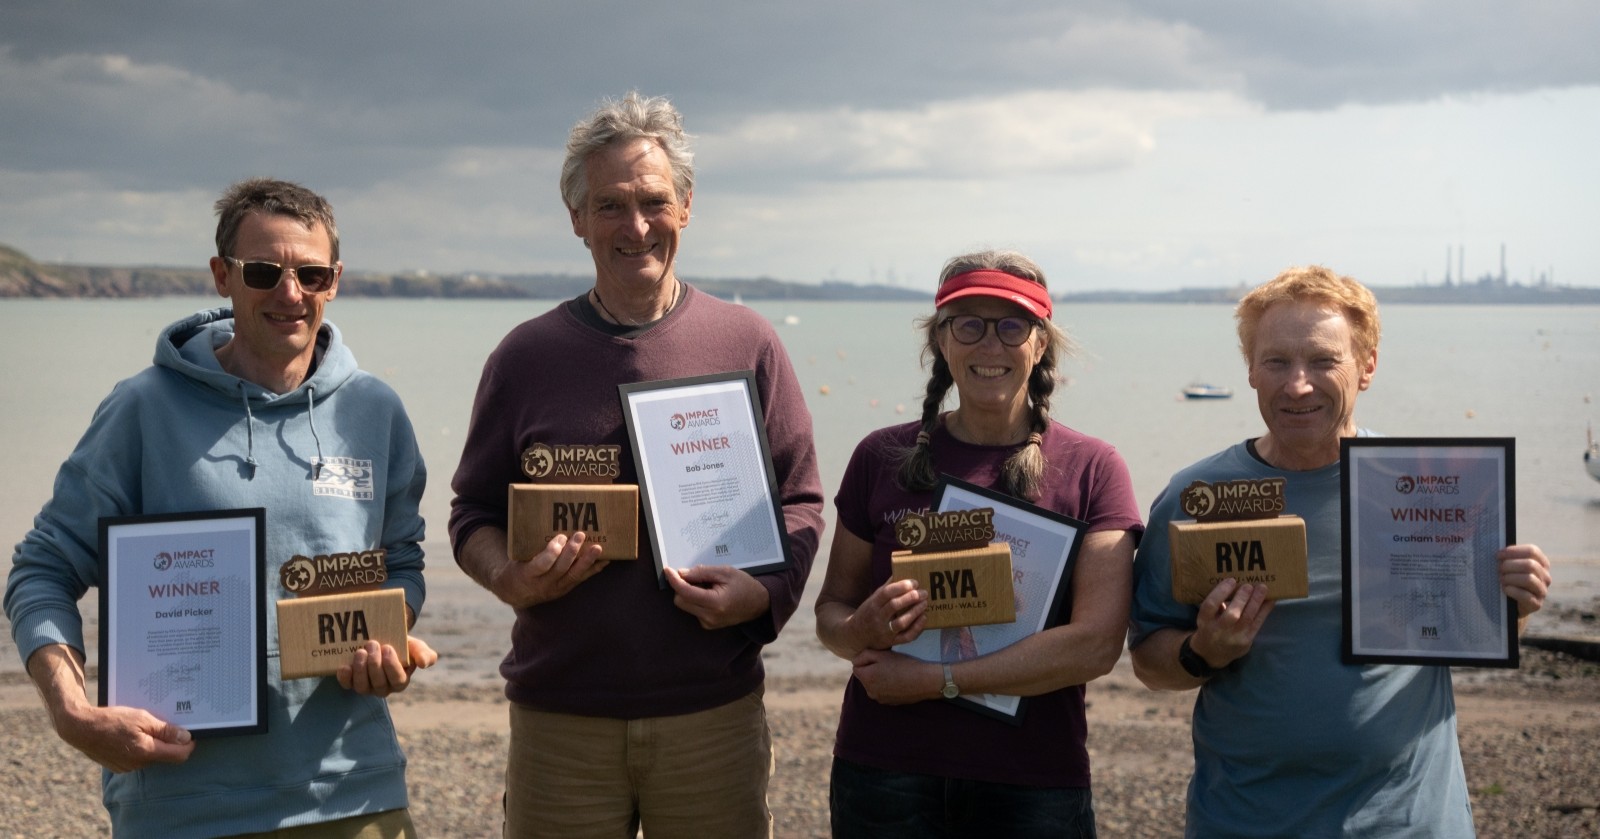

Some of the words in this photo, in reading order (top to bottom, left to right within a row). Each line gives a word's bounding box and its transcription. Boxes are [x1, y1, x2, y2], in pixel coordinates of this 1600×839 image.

[685, 408, 719, 420] IMPACT
[687, 417, 721, 429] AWARDS
[670, 436, 731, 456] WINNER
[555, 448, 618, 461] IMPACT
[555, 463, 617, 477] AWARDS
[686, 464, 701, 473] Bob
[702, 462, 725, 471] Jones
[1416, 475, 1459, 485] IMPACT
[1217, 482, 1283, 499] IMPACT
[1416, 485, 1459, 495] AWARDS
[1217, 498, 1283, 515] AWARDS
[553, 502, 599, 532] RYA
[929, 511, 991, 529] IMPACT
[1391, 508, 1467, 523] WINNER
[929, 526, 993, 544] AWARDS
[1393, 534, 1433, 543] Graham
[1435, 534, 1464, 543] Smith
[173, 549, 215, 559] IMPACT
[715, 544, 729, 554] RYA
[317, 552, 384, 573] IMPACT
[1215, 540, 1266, 574] RYA
[173, 559, 215, 569] AWARDS
[319, 569, 385, 589] AWARDS
[929, 568, 978, 601] RYA
[1246, 575, 1276, 583] WALES
[148, 581, 220, 598] WINNER
[958, 601, 987, 609] WALES
[155, 609, 183, 619] David
[184, 607, 213, 617] Picker
[318, 610, 370, 644] RYA
[1422, 626, 1438, 637] RYA
[311, 646, 343, 657] CYMRU
[176, 700, 191, 711] RYA
